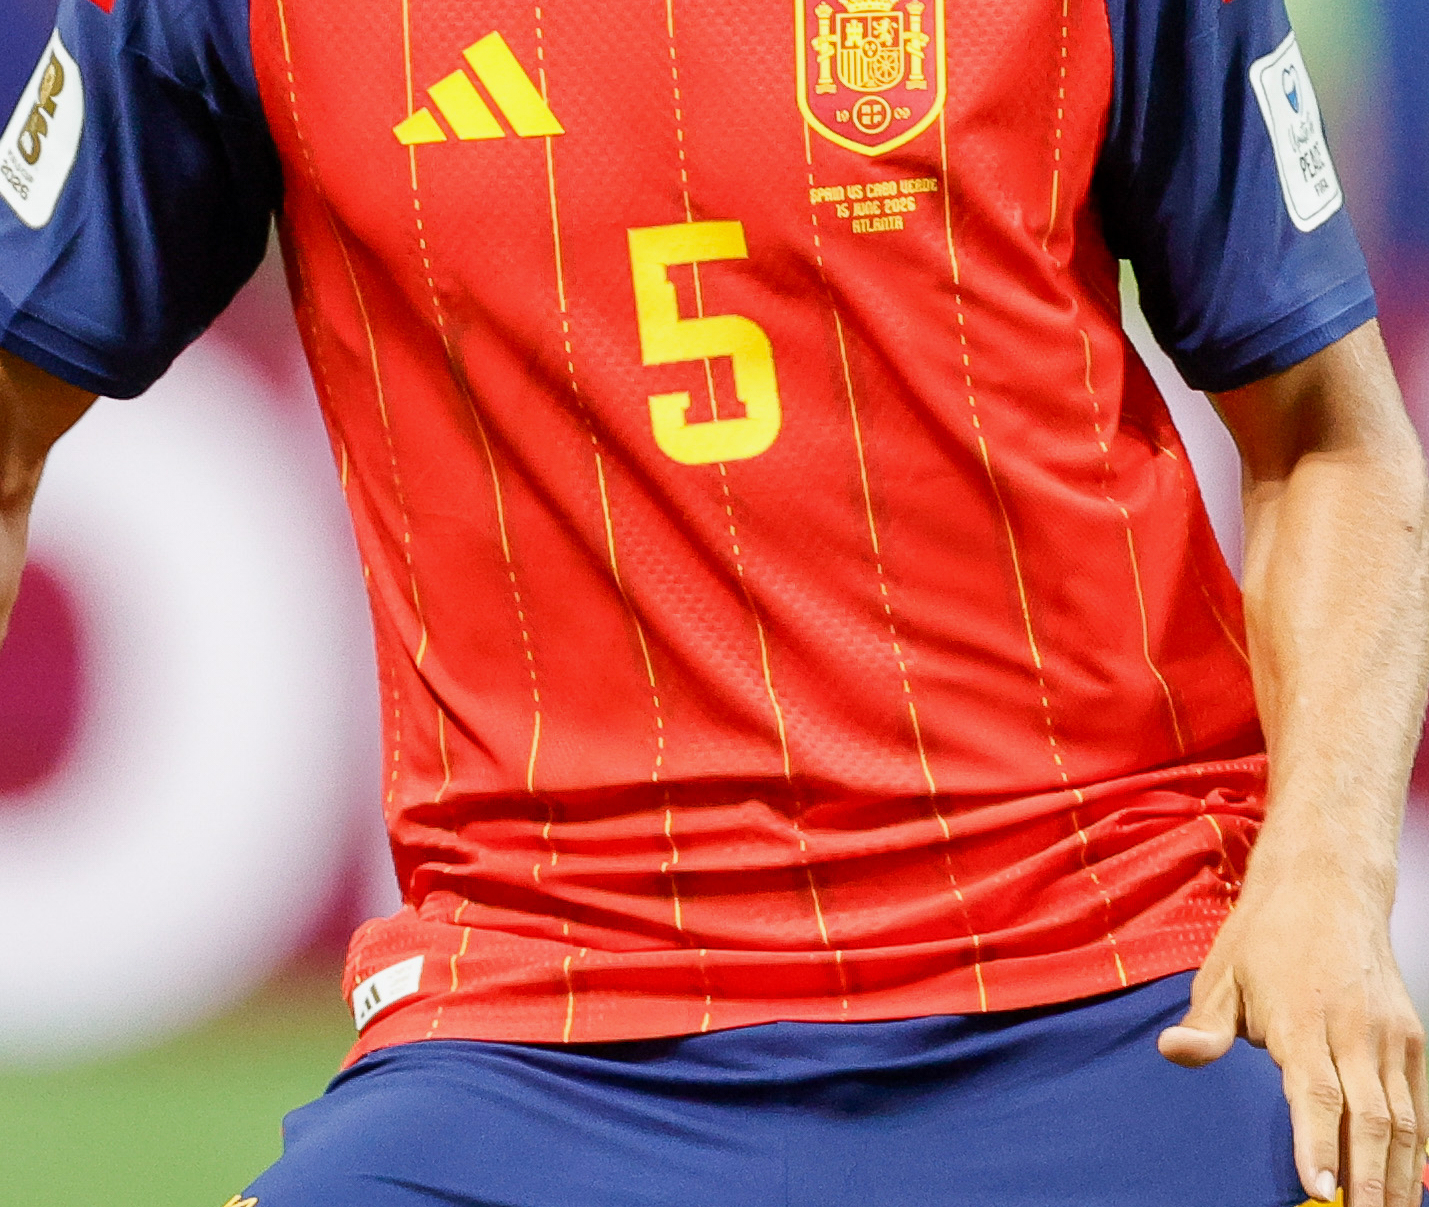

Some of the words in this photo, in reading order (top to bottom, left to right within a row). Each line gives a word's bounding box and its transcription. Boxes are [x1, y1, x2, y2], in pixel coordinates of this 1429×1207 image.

[809, 185, 845, 205] SPAIN
[866, 181, 898, 198] CABO
[835, 202, 850, 218] 15
[853, 200, 881, 217] JUNE
[883, 196, 916, 214] 2026
[852, 215, 904, 234] ATLANTA
[627, 219, 783, 465] 5
